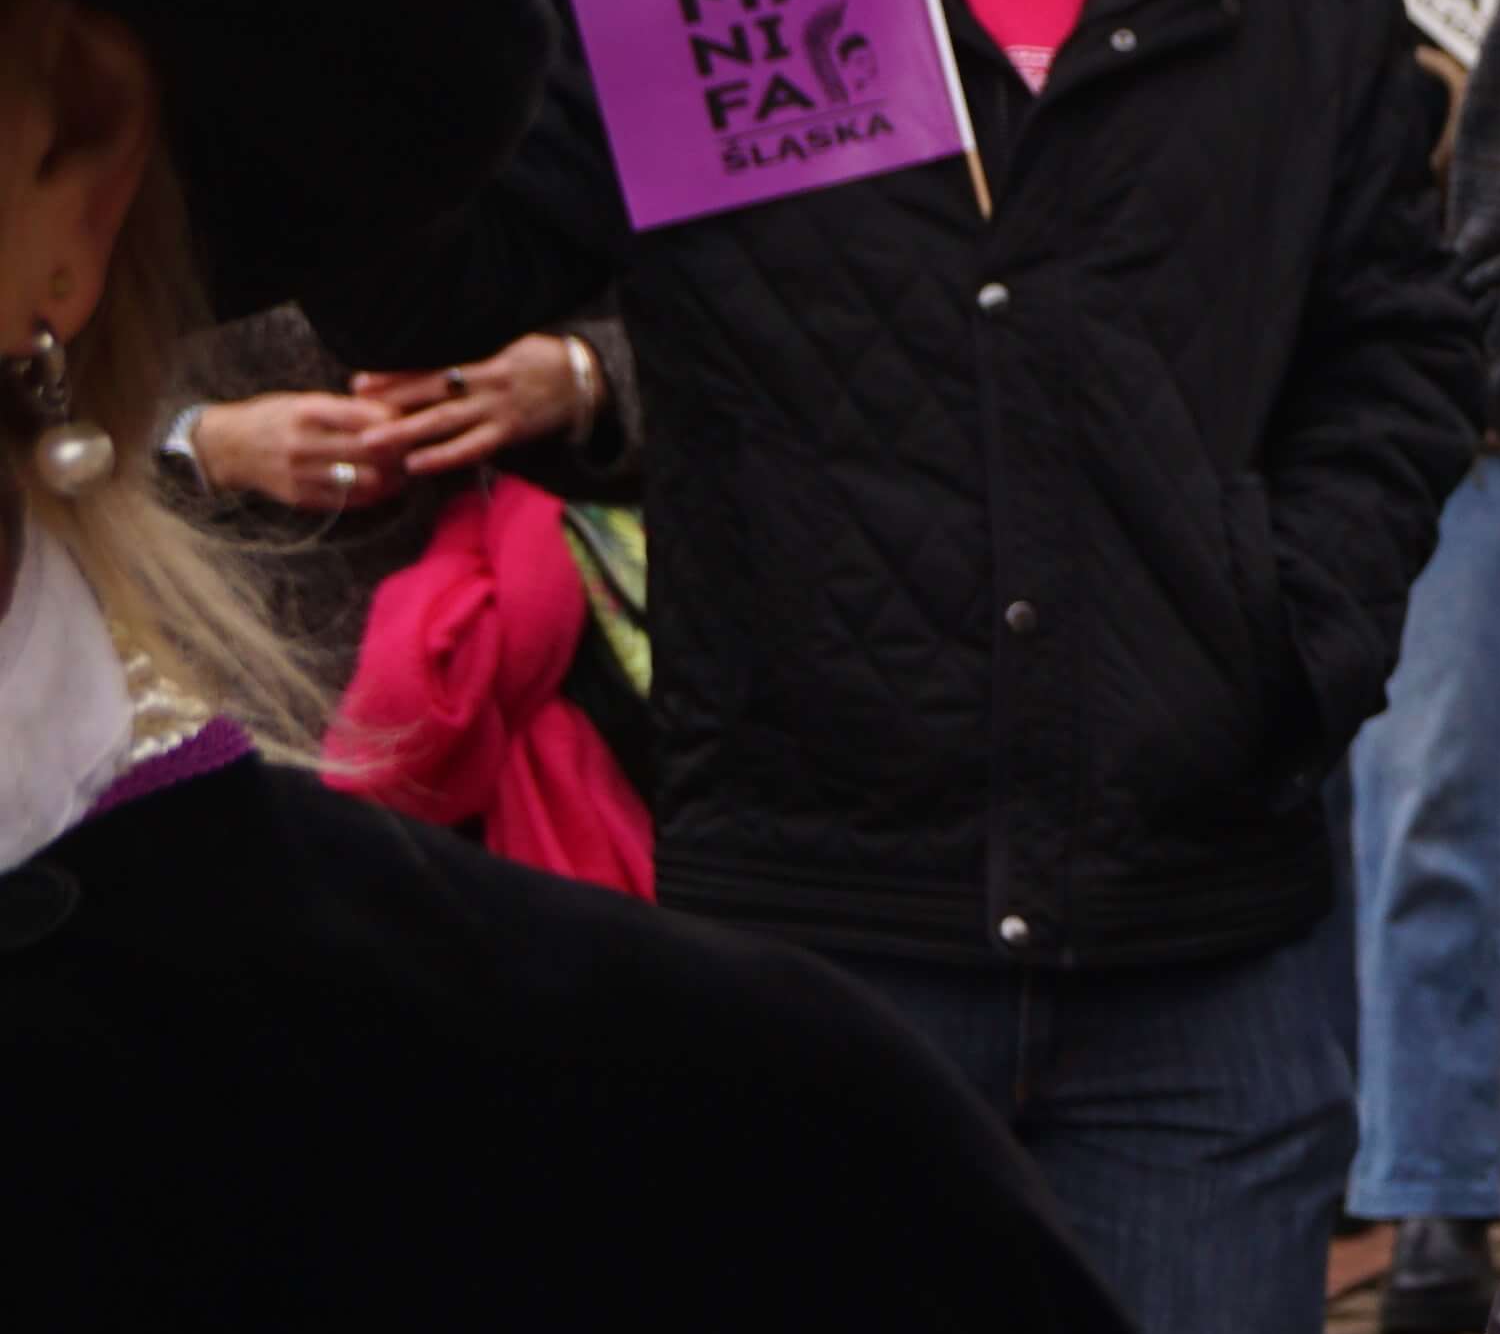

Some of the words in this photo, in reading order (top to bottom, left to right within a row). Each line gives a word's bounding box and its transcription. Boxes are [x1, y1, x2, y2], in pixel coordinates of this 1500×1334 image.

[688, 13, 789, 76] NI
[704, 72, 817, 133] FA
[720, 109, 895, 176] ŚLĄSKA
